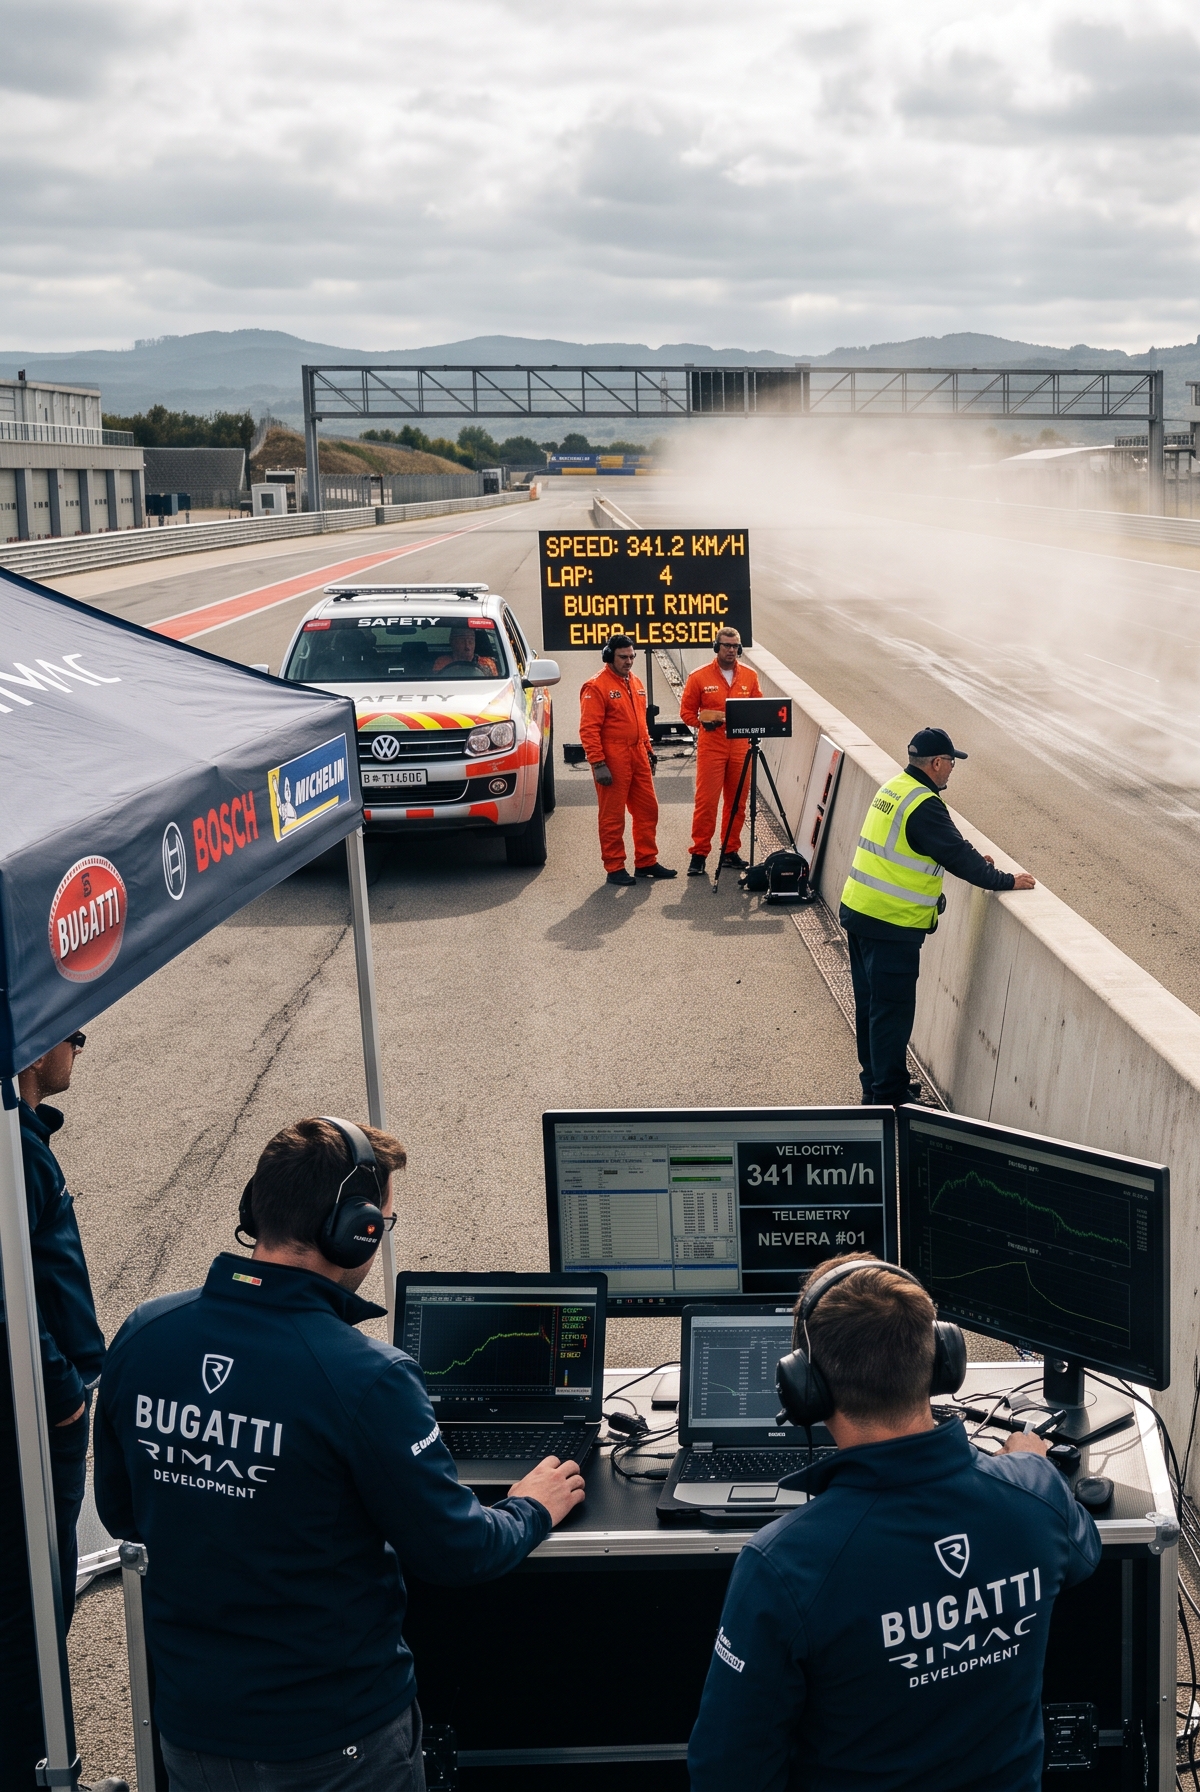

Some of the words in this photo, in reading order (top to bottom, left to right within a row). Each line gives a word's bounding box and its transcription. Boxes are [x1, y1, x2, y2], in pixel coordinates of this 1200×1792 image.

[546, 536, 619, 557] SPEED:
[627, 535, 684, 557] 341.2
[692, 534, 745, 556] KM/H
[547, 566, 593, 587] LAP:
[660, 565, 673, 586] 4
[564, 594, 655, 617] BUGATTI
[664, 593, 729, 615] RIMAC
[357, 617, 441, 627] SAFETY
[352, 694, 455, 704] AFETY
[295, 757, 345, 807] MICHELIN
[192, 790, 259, 873] BOSCH
[57, 887, 121, 960] BUGATTI
[776, 1145, 844, 1156] VELOCITY:
[746, 1163, 793, 1186] 341
[806, 1162, 875, 1186] km/h
[772, 1210, 851, 1221] TELEMETRY
[758, 1231, 831, 1246] NEVERA
[835, 1231, 865, 1245] #01
[135, 1394, 283, 1457] BUGATTI
[138, 1438, 276, 1483] RIMAC
[153, 1468, 256, 1500] DEVELOPMENT
[881, 1566, 1042, 1648] BUGATTI
[888, 1612, 1038, 1669] RIMAC
[909, 1644, 1020, 1688] DEVELOPMENT
